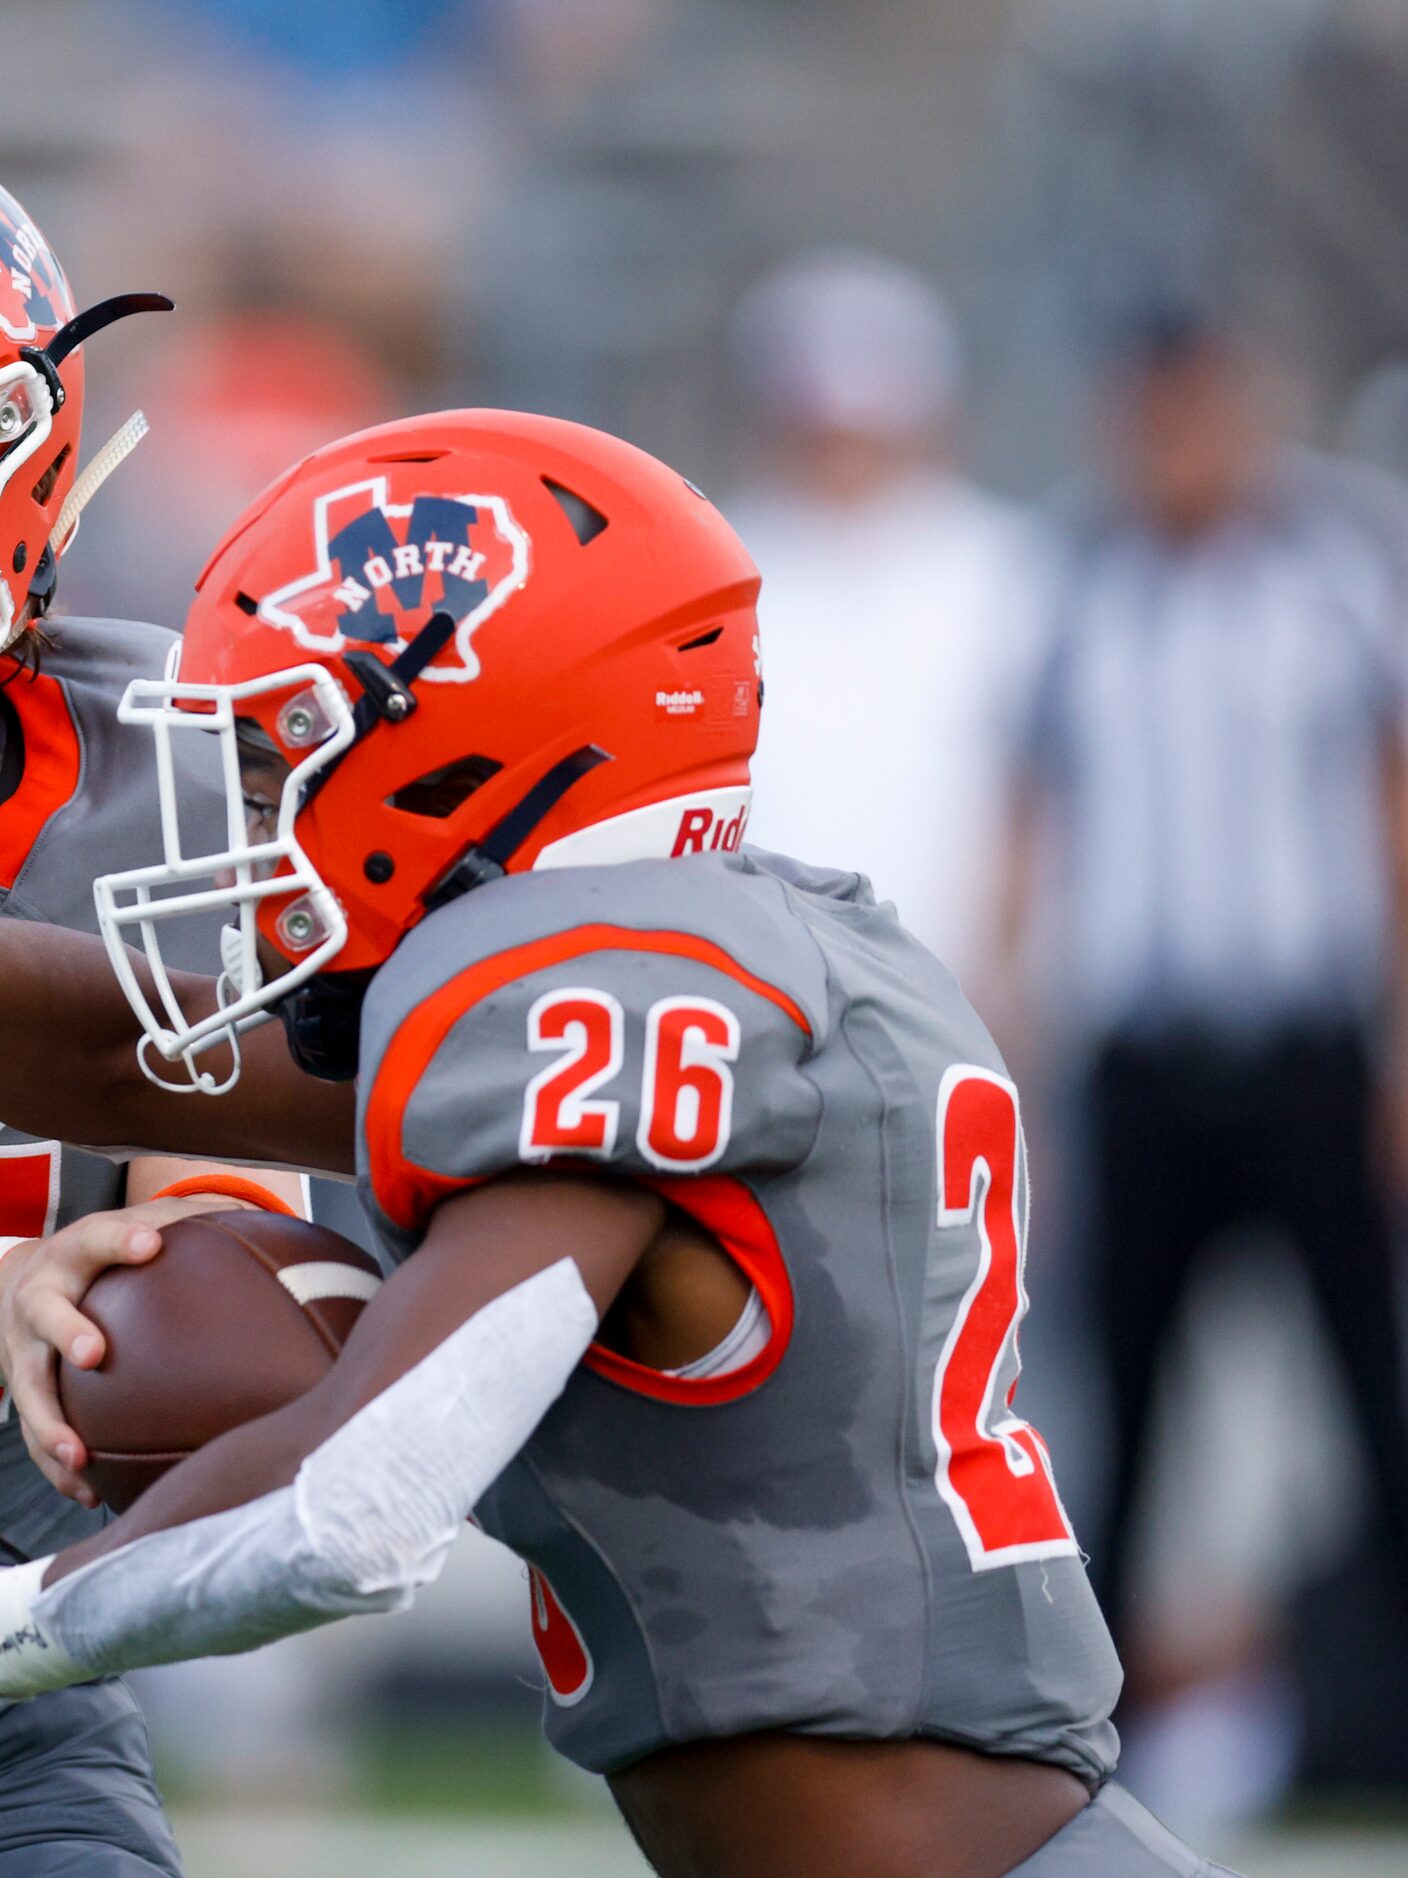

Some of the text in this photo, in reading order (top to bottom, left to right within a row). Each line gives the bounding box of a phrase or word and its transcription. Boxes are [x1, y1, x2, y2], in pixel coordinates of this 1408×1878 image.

[333, 541, 486, 613] NORTH
[670, 804, 748, 859] Rid
[519, 987, 741, 1173] 26
